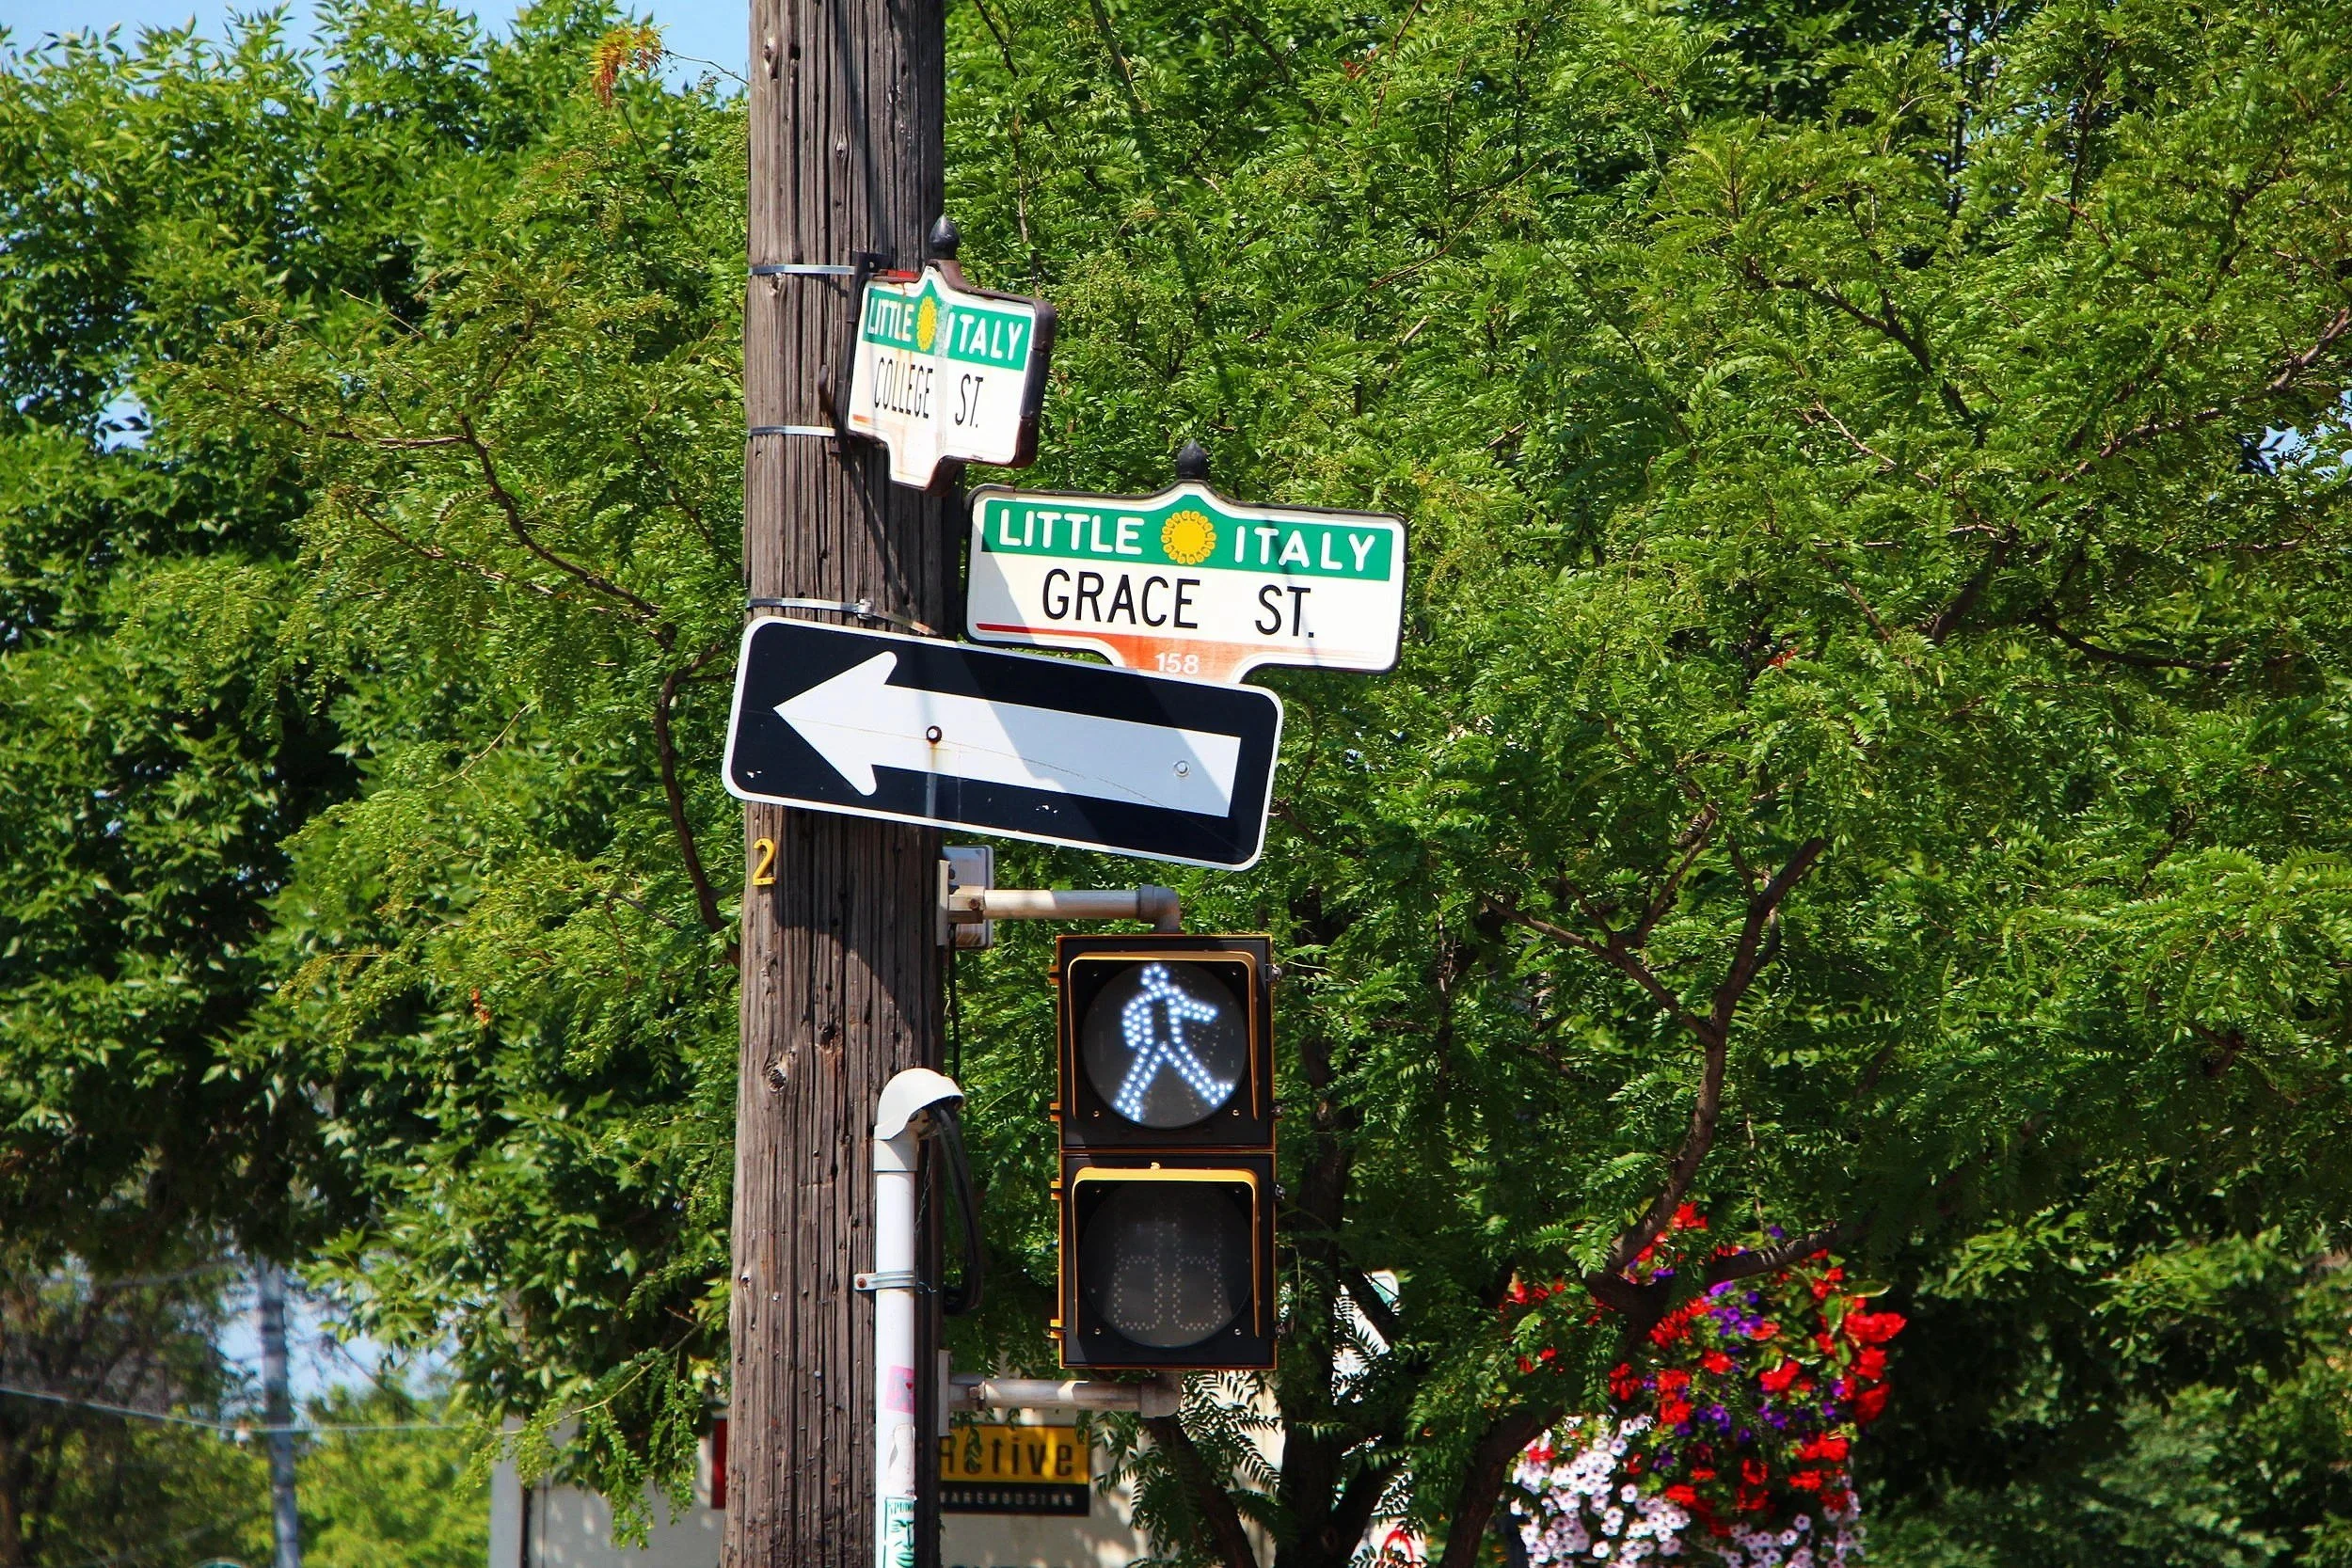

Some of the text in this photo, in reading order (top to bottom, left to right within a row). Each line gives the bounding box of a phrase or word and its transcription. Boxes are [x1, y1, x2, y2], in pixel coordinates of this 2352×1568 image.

[866, 295, 1024, 361] LITTLE ITALY
[874, 356, 984, 429] COLLEGE ST.
[998, 507, 1375, 572] LITTLE ITALY
[1041, 568, 1315, 639] GRACE ST.
[1154, 652, 1200, 675] 158
[752, 837, 776, 886] 2
